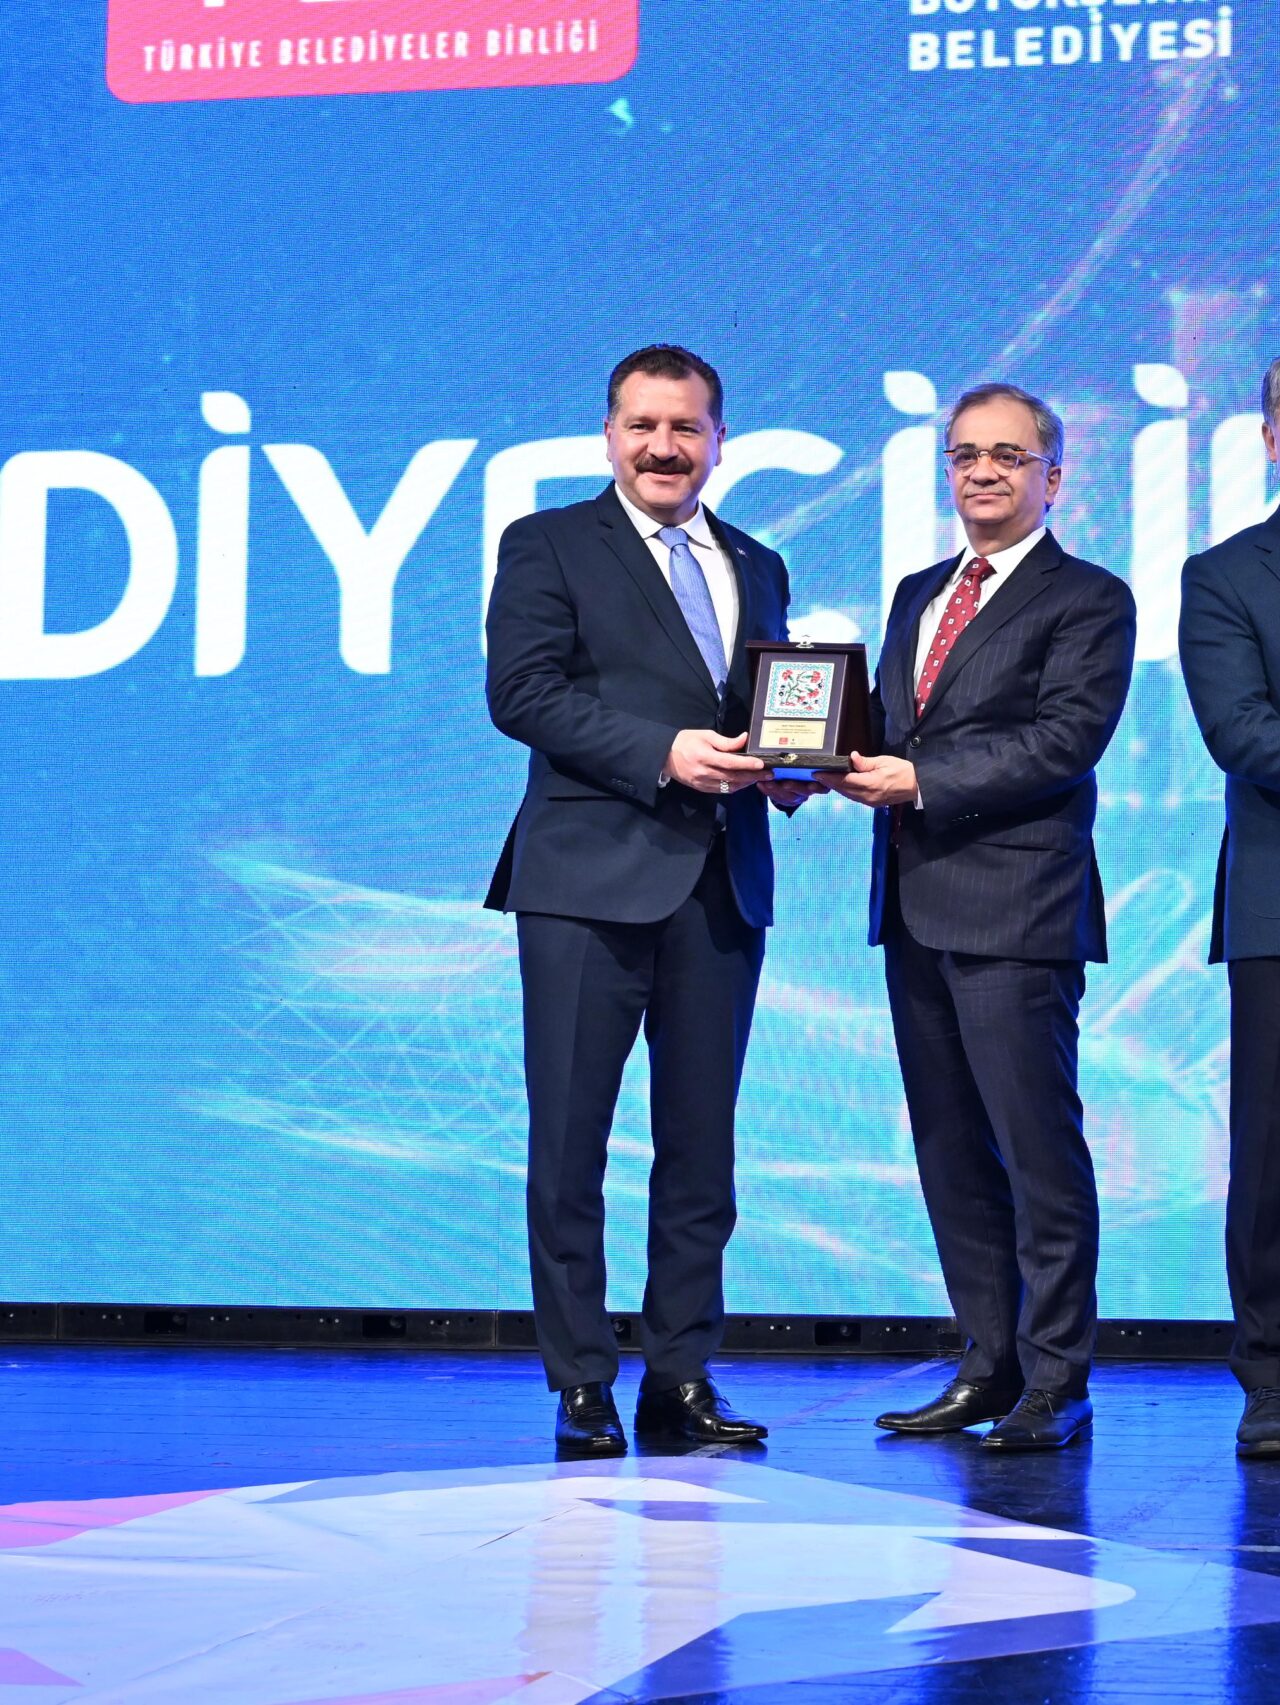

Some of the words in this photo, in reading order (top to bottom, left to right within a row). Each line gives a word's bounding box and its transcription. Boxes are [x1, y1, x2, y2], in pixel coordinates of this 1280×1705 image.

[143, 37, 262, 72] TÜRKİYE
[278, 30, 470, 67] BELEDİYELER
[486, 19, 599, 58] BİRLİĞİ
[908, 5, 1233, 71] BELEDİYESİ
